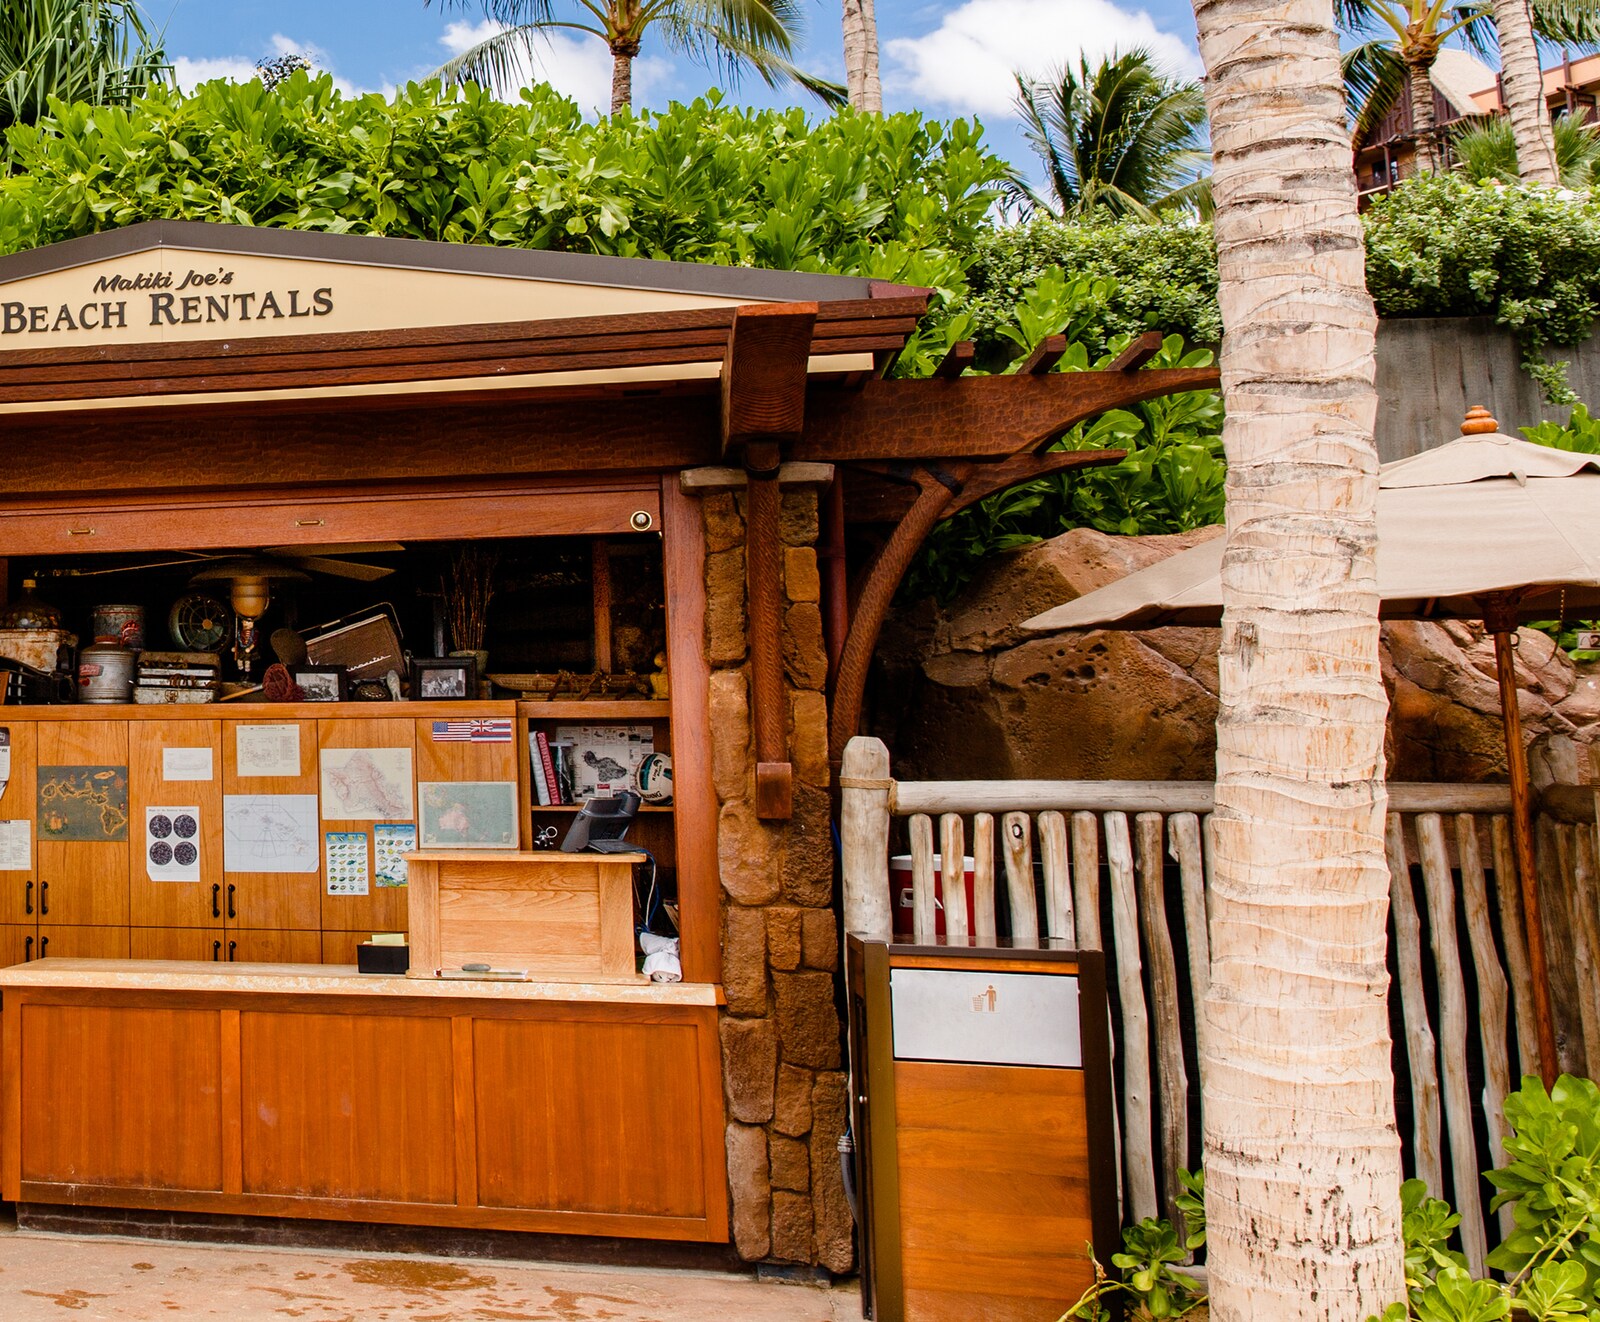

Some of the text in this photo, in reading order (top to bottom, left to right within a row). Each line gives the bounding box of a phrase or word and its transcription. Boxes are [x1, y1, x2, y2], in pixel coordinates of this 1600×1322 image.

[93, 267, 234, 293] Makiki Joe's
[1, 287, 333, 334] BEACH RENTALS
